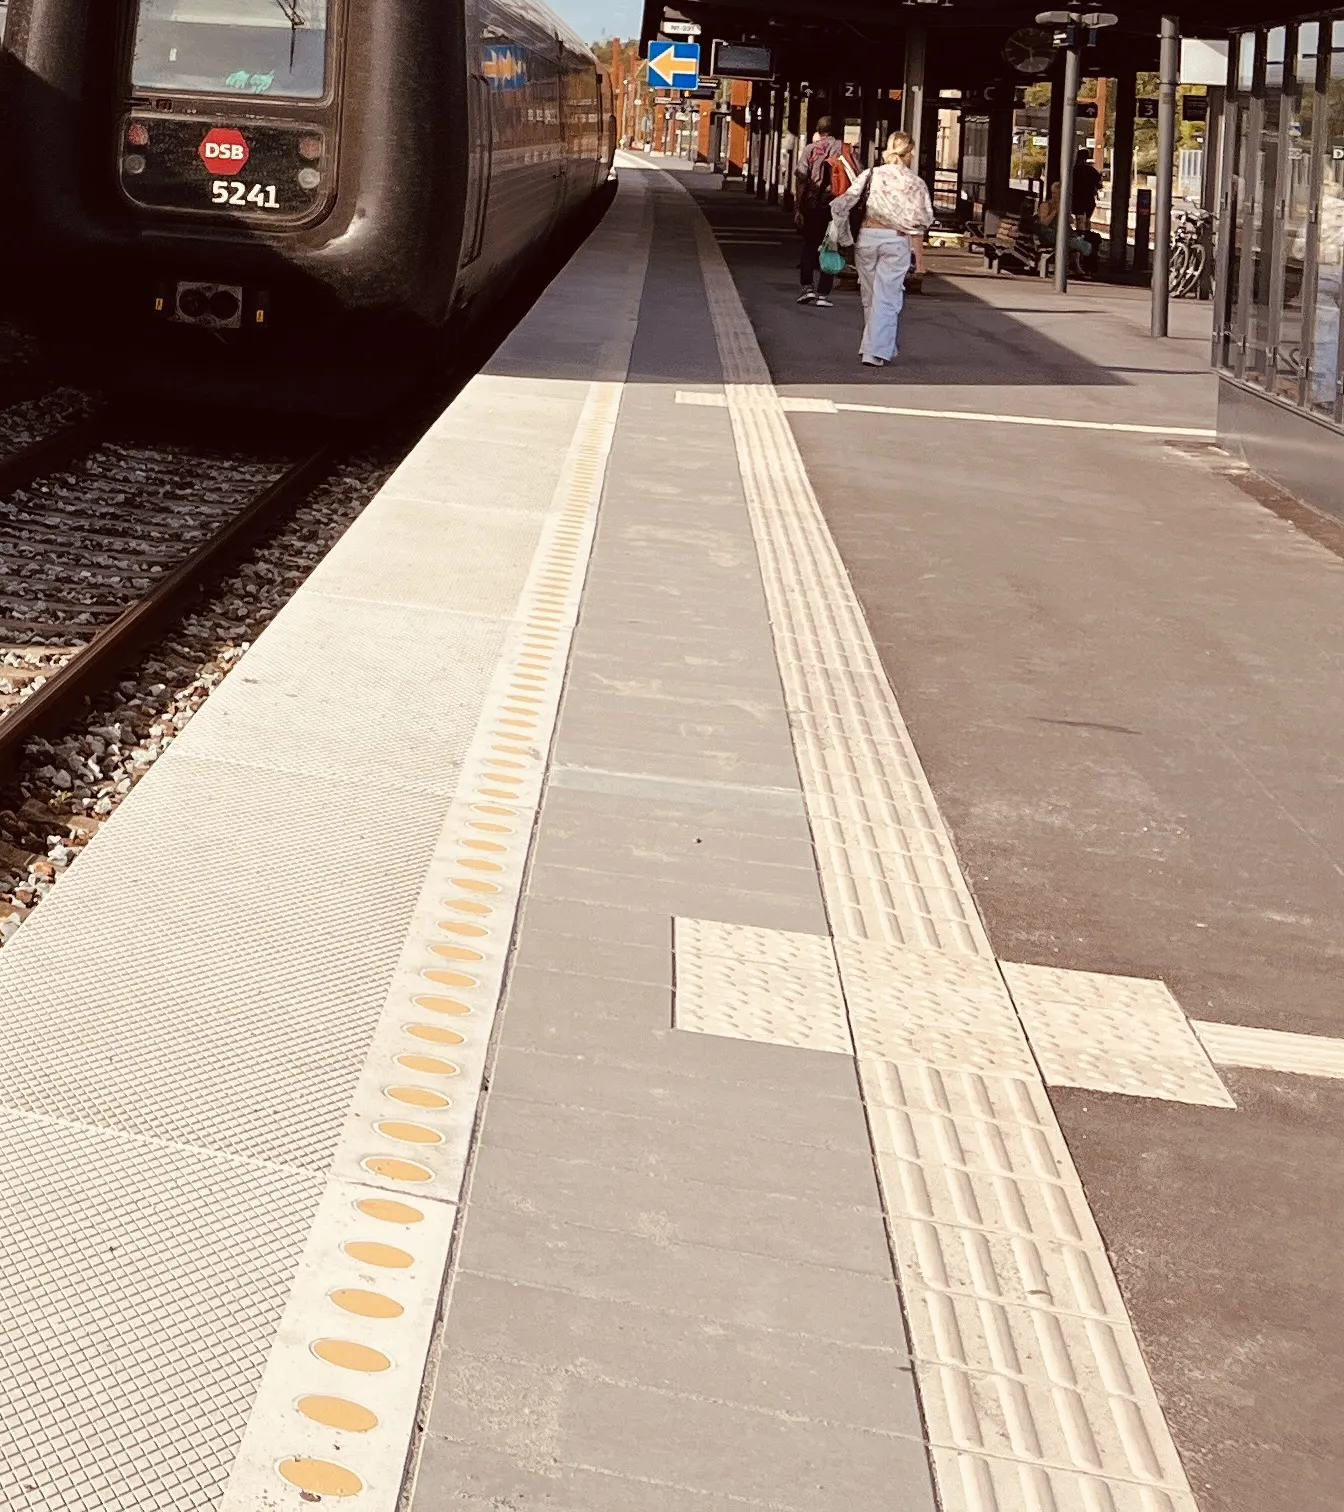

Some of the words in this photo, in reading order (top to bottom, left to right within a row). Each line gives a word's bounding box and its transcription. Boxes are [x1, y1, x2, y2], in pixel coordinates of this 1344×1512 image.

[844, 85, 854, 97] 2
[1144, 104, 1154, 116] 3
[204, 141, 245, 161] DSB
[211, 180, 281, 209] 5241
